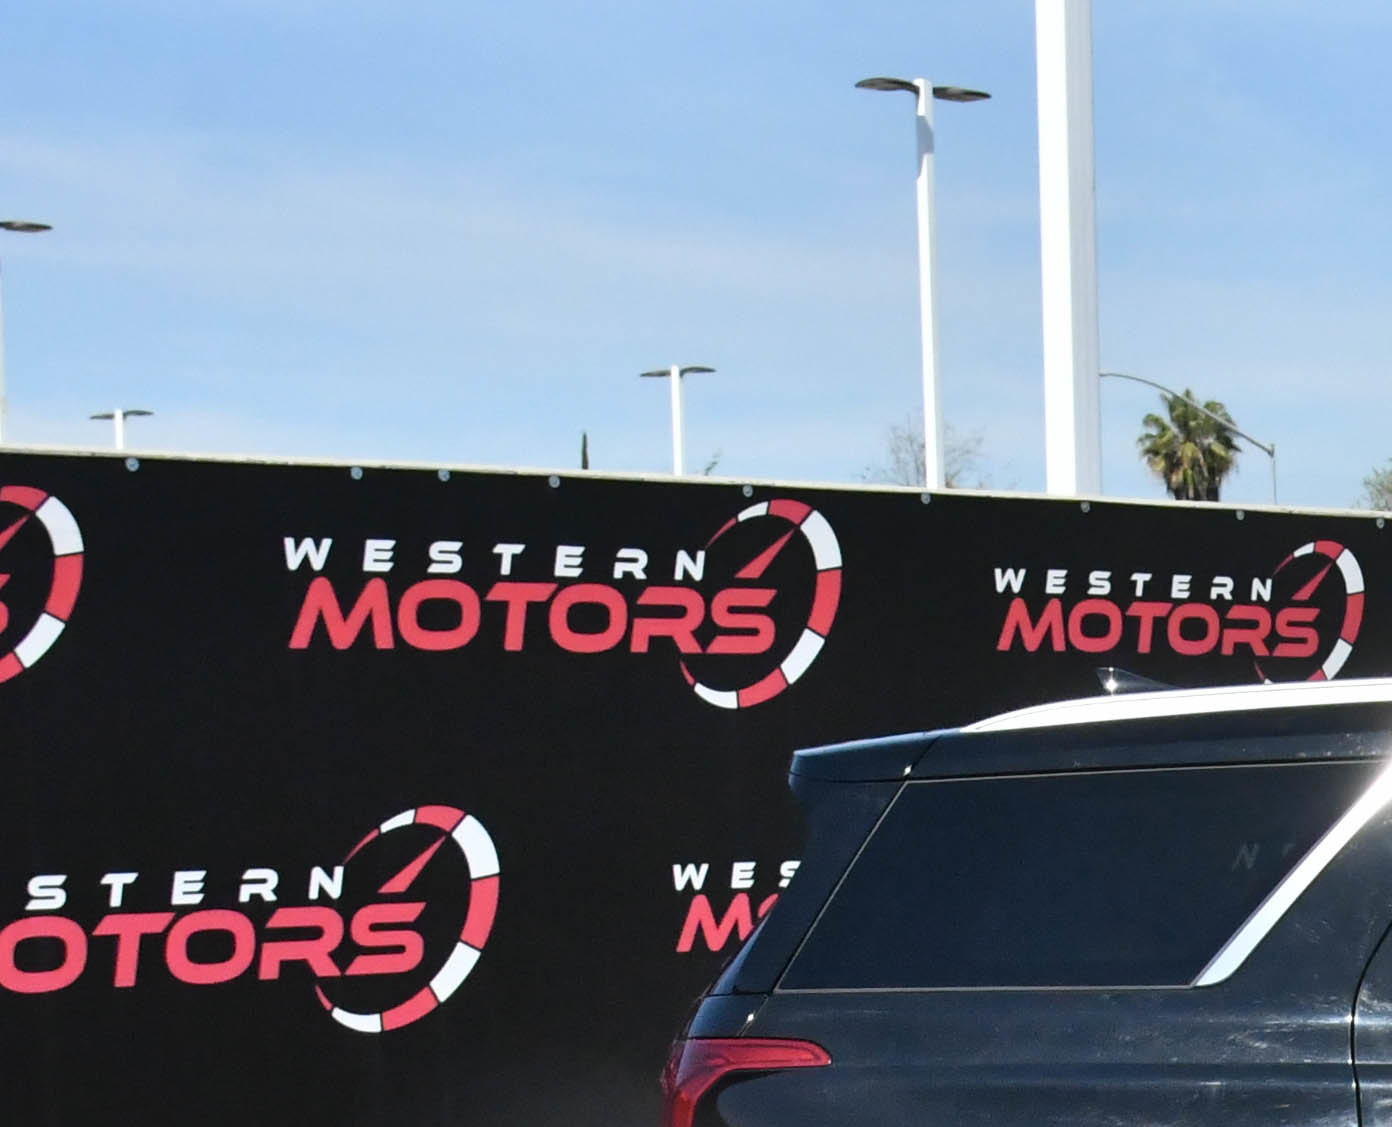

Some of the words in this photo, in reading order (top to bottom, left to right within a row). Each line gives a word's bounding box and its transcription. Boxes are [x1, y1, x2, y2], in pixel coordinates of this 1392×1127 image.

[283, 536, 706, 582] WESTERN
[994, 567, 1273, 602] WESTERN
[288, 575, 777, 655] MOTORS
[996, 597, 1321, 658] MOTORS
